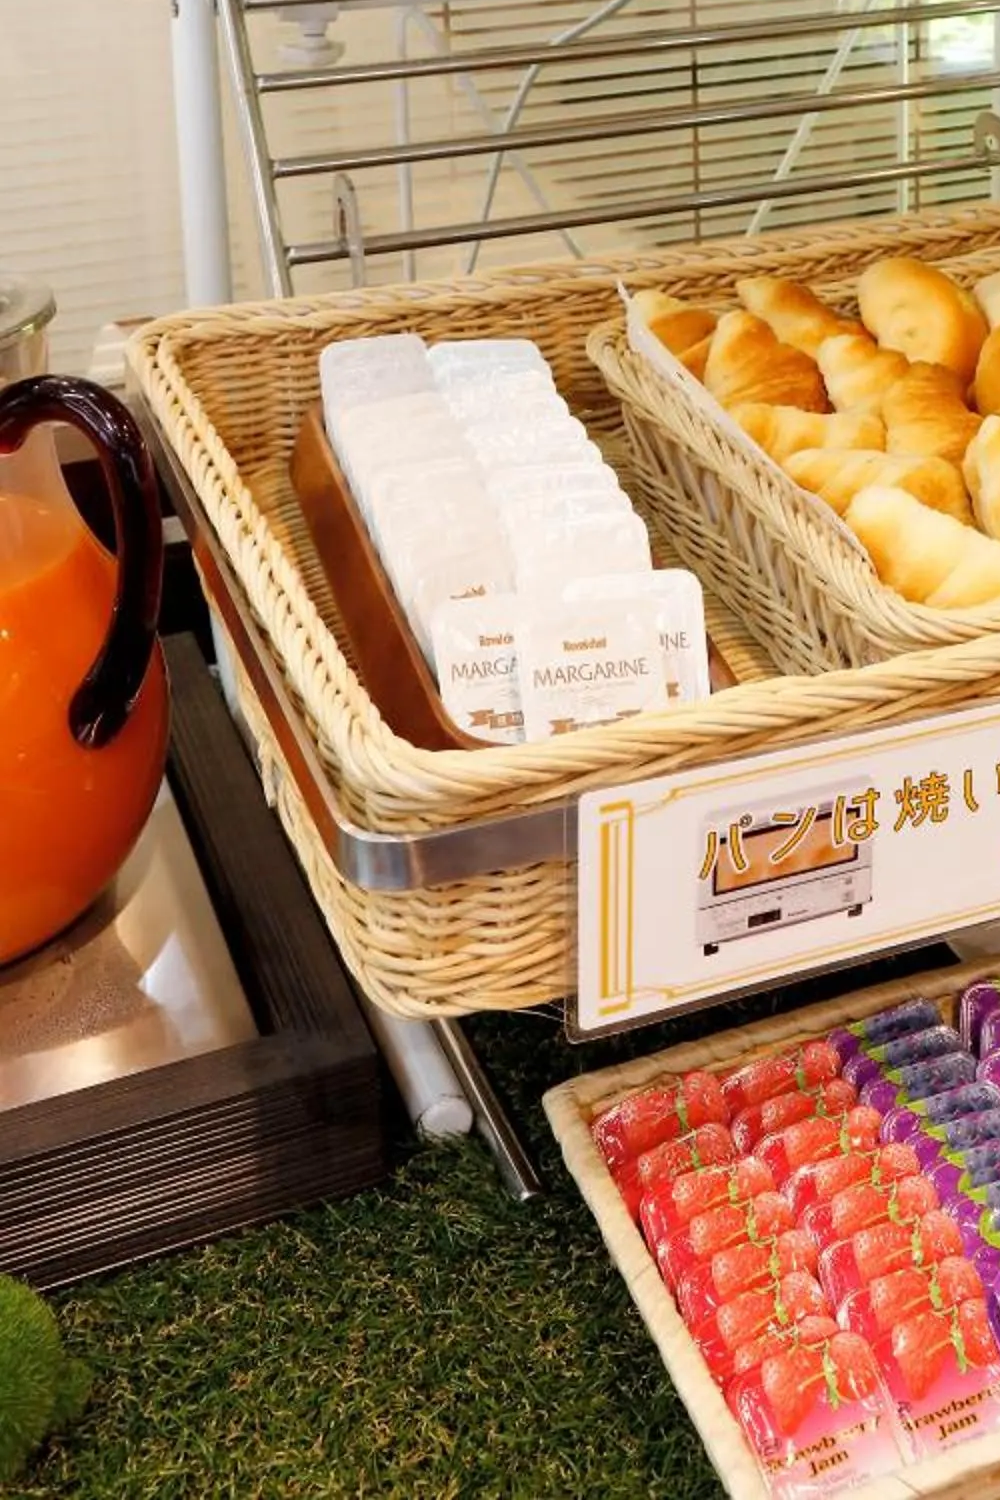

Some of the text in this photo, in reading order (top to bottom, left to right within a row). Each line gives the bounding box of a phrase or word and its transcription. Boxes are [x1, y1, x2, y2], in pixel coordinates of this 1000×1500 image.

[533, 657, 650, 689] MARGARINE
[938, 1412, 978, 1441] Jam
[809, 1449, 850, 1479] Jam
